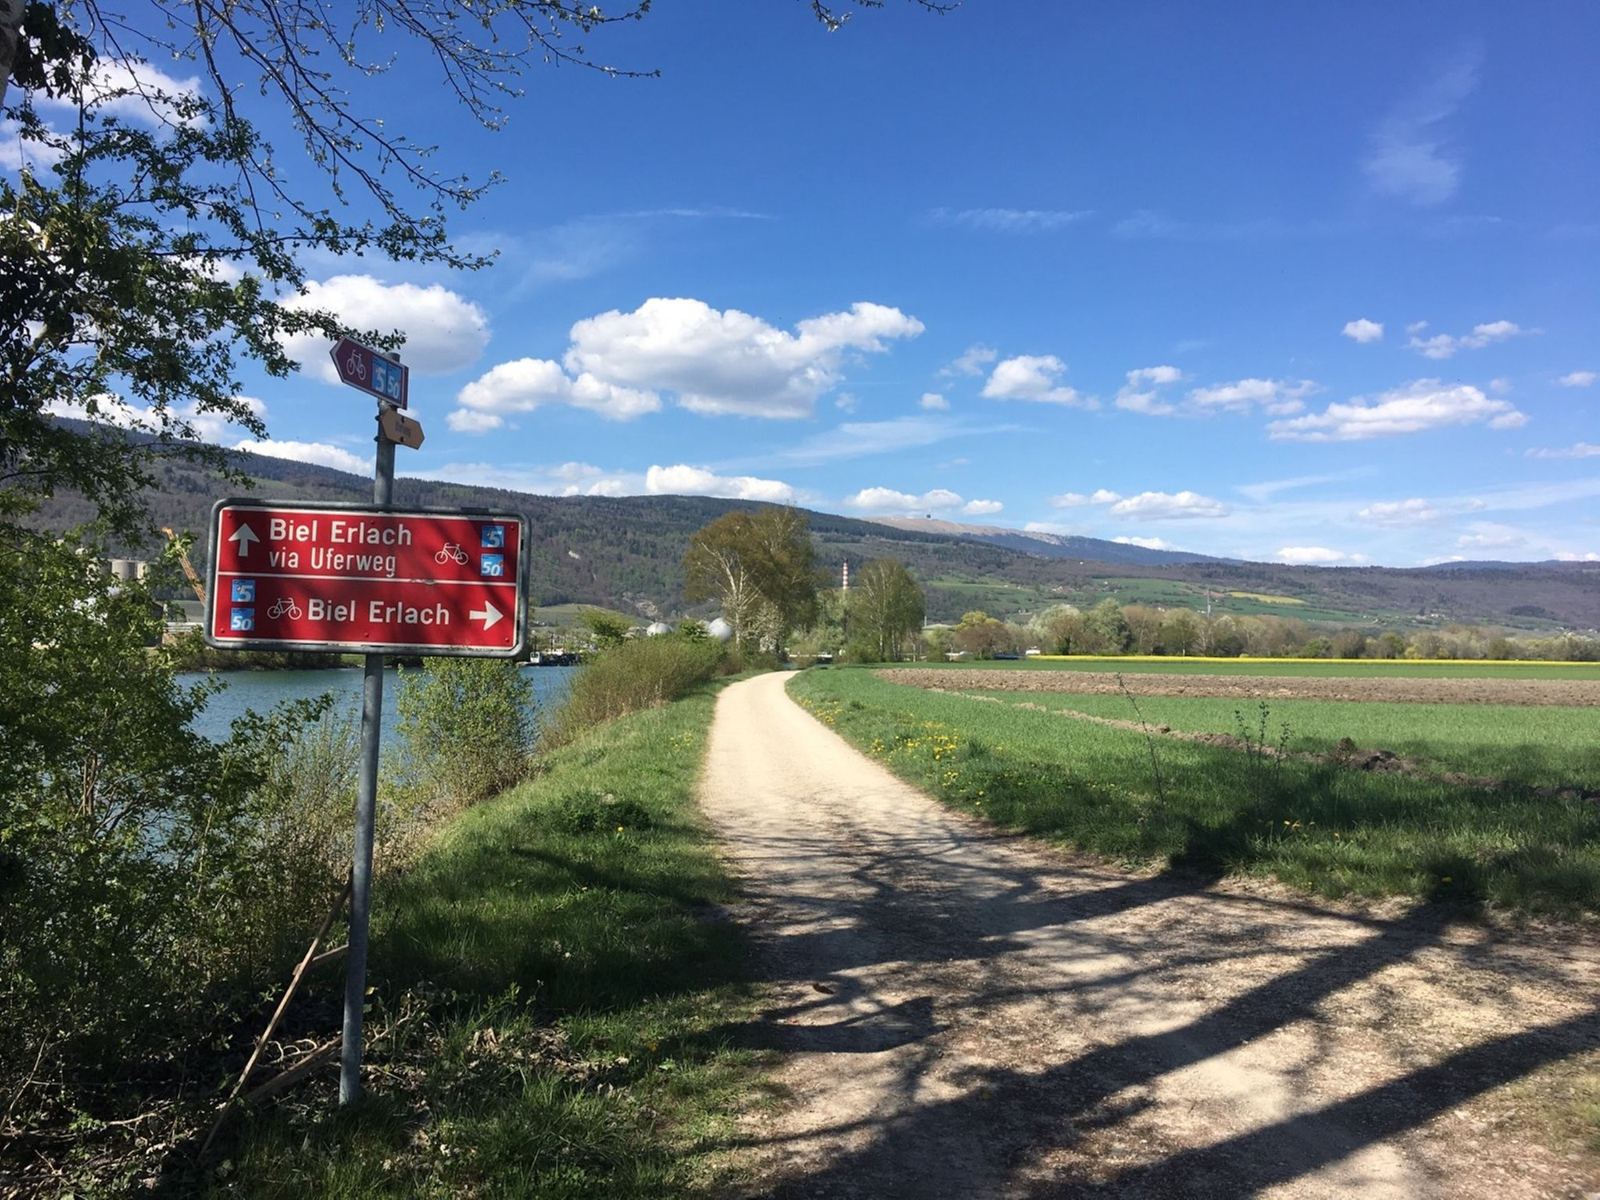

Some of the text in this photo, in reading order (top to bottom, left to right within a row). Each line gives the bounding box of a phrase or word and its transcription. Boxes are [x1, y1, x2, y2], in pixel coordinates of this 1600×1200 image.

[269, 518, 412, 545] Biel Erlach
[489, 530, 503, 547] 5
[269, 547, 396, 577] via Uferweg
[481, 561, 501, 577] 50
[238, 585, 253, 602] 5
[308, 599, 449, 625] Biel Erlach
[231, 615, 252, 631] 50
